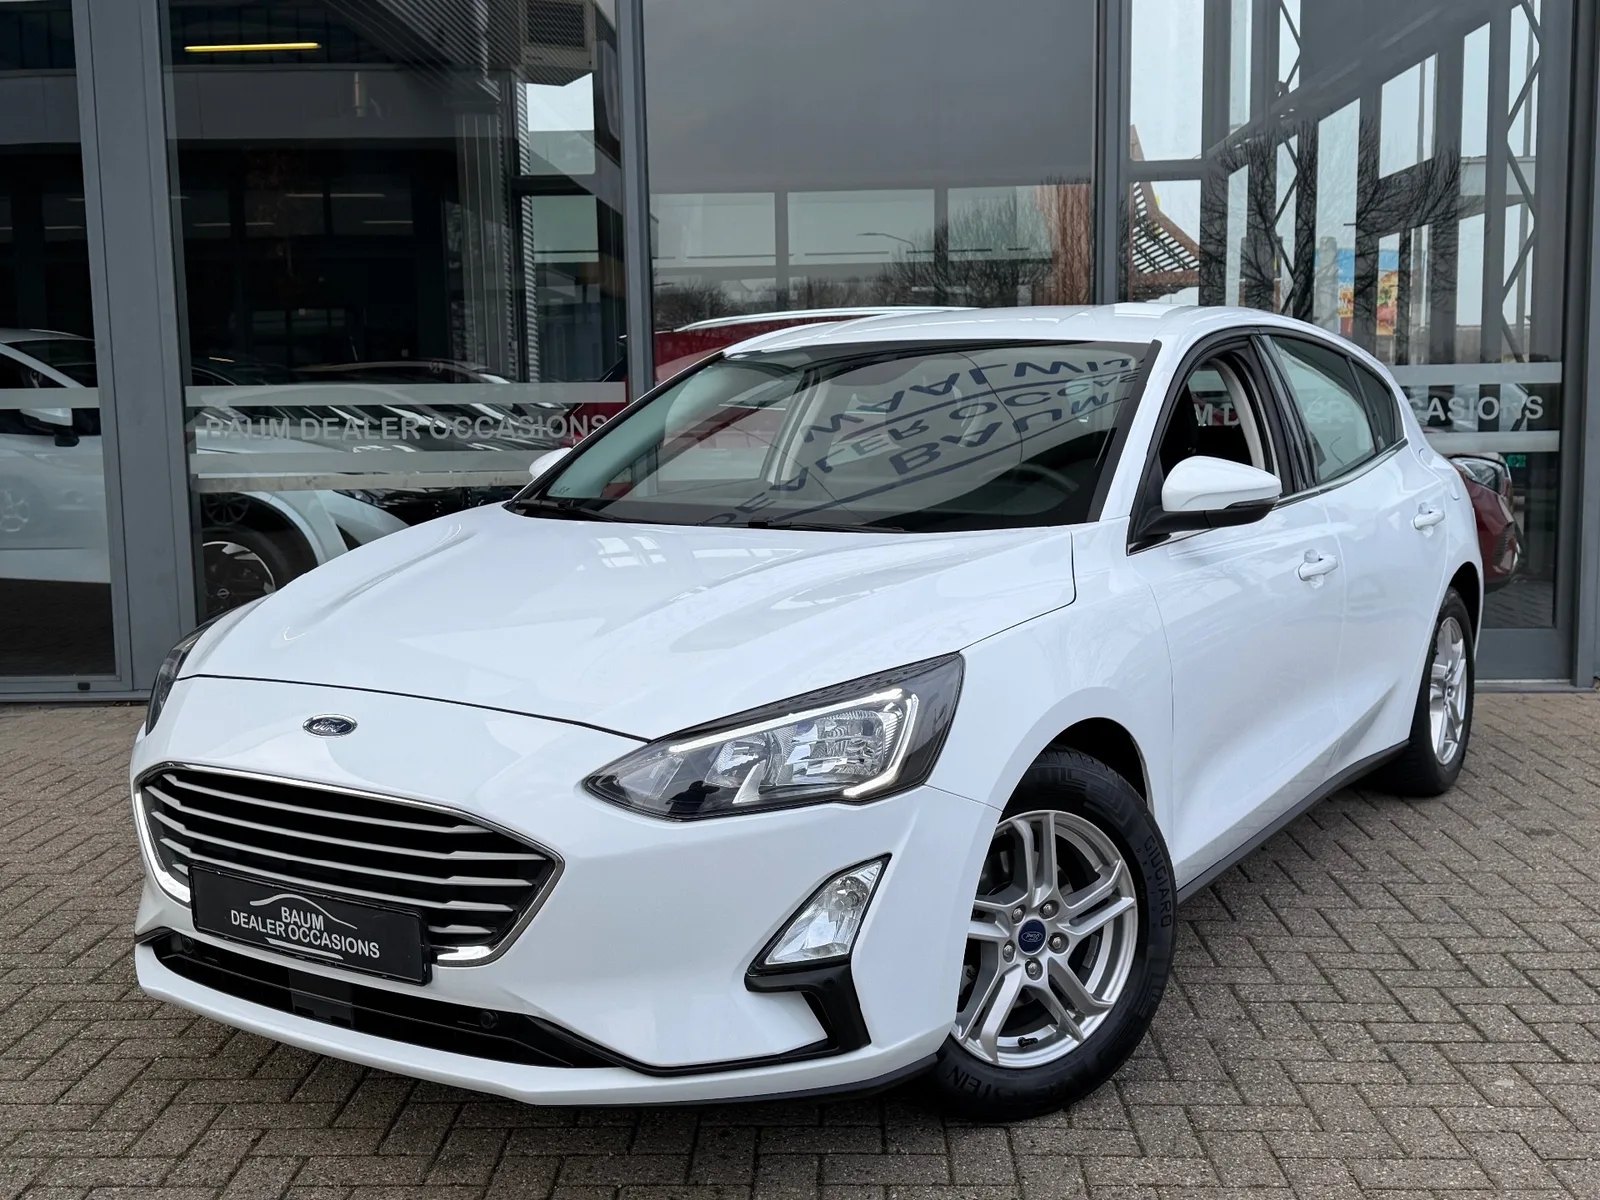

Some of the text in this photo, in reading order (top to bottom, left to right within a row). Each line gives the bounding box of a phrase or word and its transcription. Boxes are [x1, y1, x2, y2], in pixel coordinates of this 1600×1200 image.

[206, 414, 608, 440] BAUM DEALER OCCASIONS
[1144, 834, 1173, 928] GIUGIARO
[231, 910, 380, 959] DEALER OCCASIONS
[281, 906, 325, 931] BAUM
